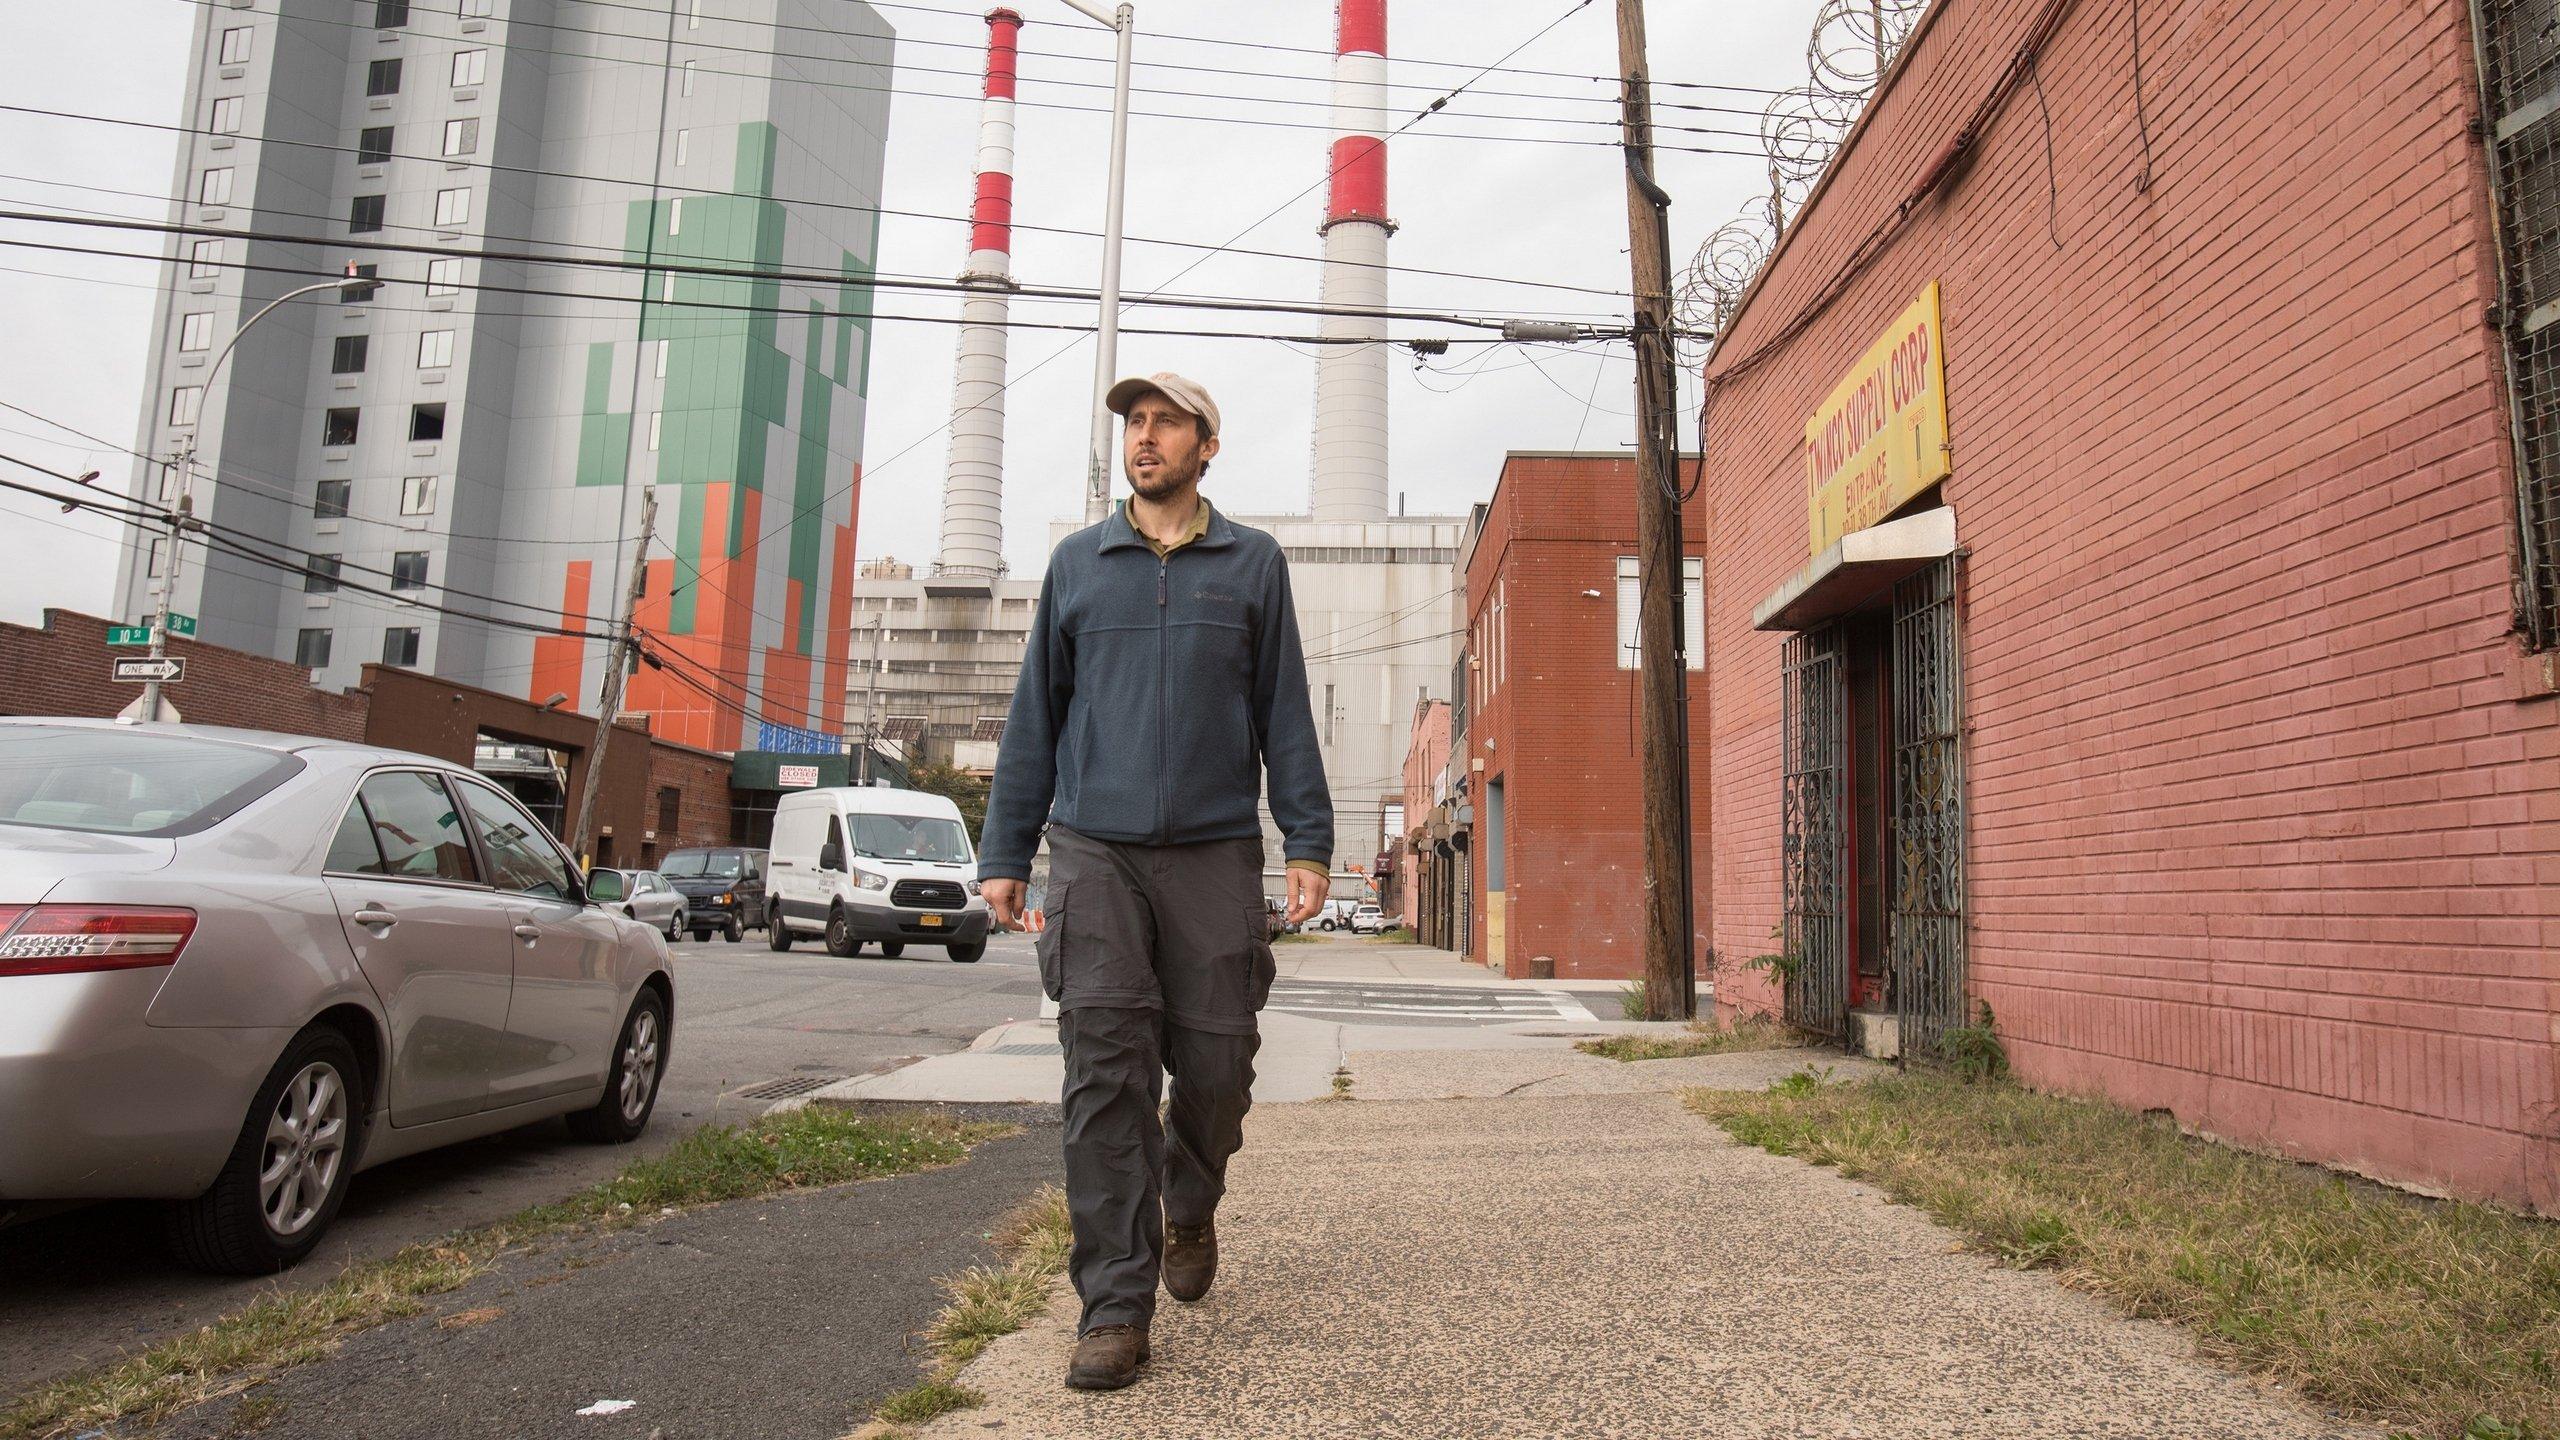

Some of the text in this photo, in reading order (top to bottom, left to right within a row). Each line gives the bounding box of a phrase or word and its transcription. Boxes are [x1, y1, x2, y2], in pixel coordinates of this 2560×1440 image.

[1808, 322, 1929, 498] TWINCO SUPPLY CORP
[1846, 450, 1887, 514] ENTRANCE
[1858, 497, 1877, 532] 38TH
[172, 615, 182, 630] 38
[120, 629, 131, 643] 10
[124, 664, 174, 674] ONE WAY
